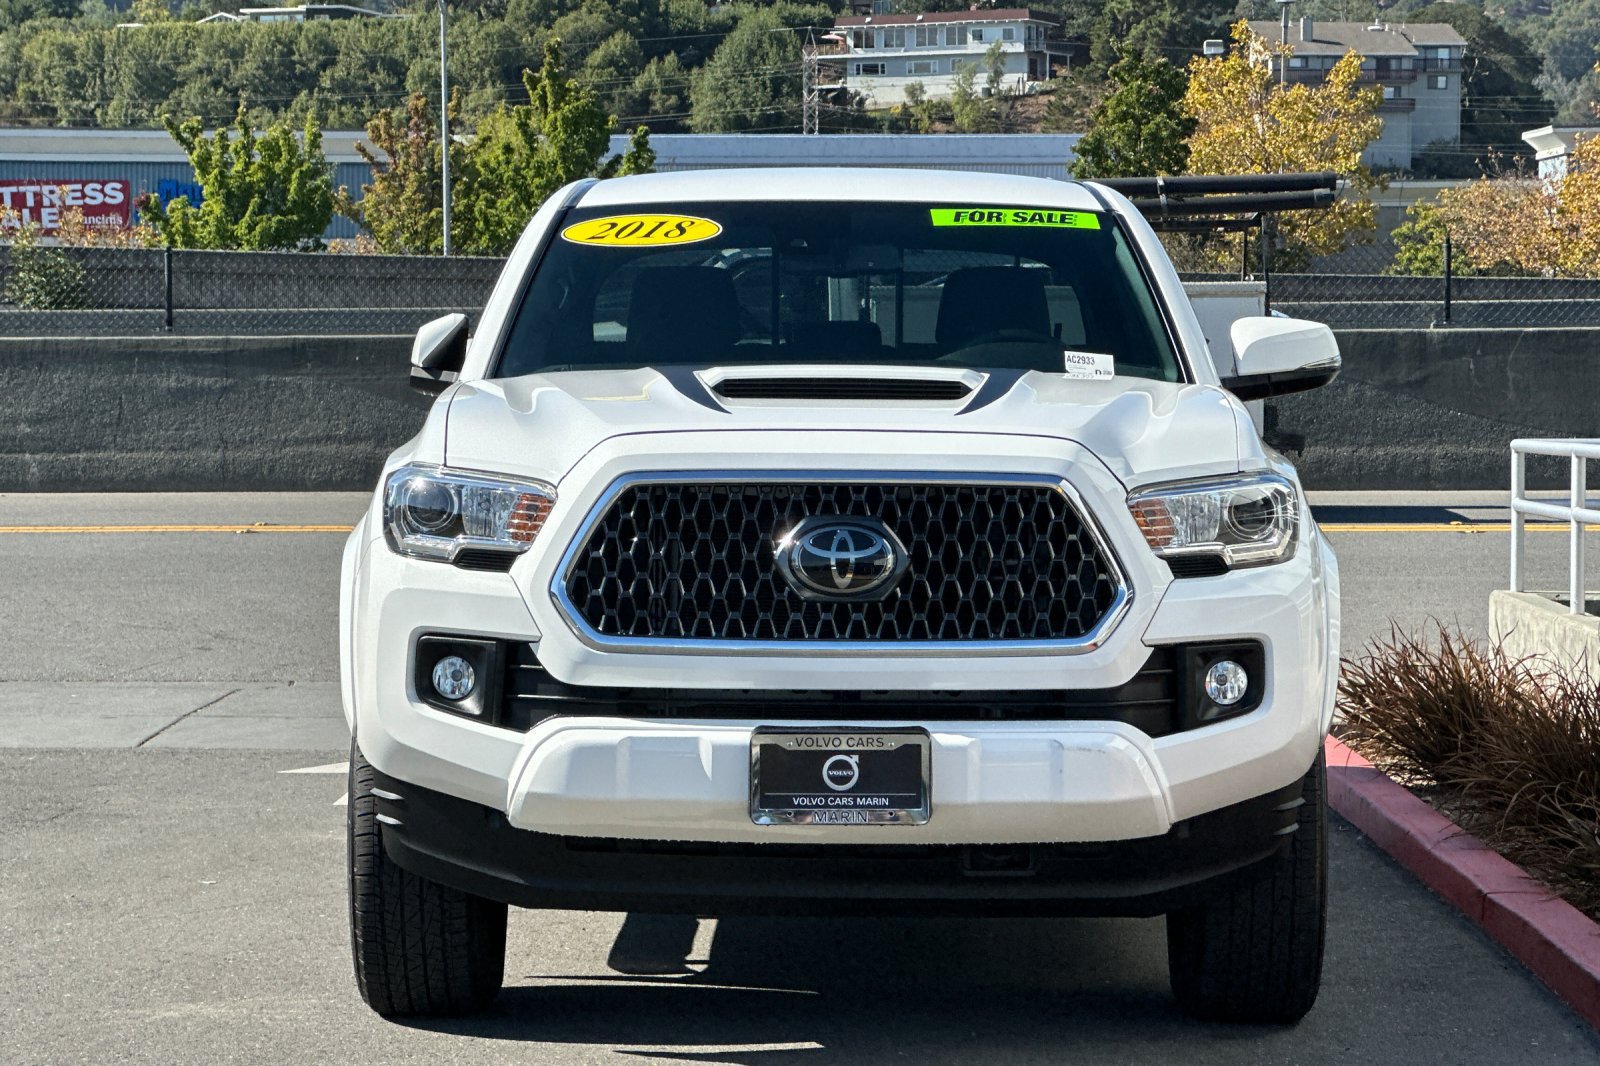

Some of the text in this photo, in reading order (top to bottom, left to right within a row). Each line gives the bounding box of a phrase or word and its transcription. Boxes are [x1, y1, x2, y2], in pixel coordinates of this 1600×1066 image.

[953, 210, 1075, 225] FOR SALE
[586, 220, 695, 240] 2018
[1066, 355, 1096, 366] AC2933
[795, 737, 884, 748] VOLVO CARS
[793, 797, 889, 806] VOLVO CARS MARIN
[812, 810, 869, 824] MARIN
